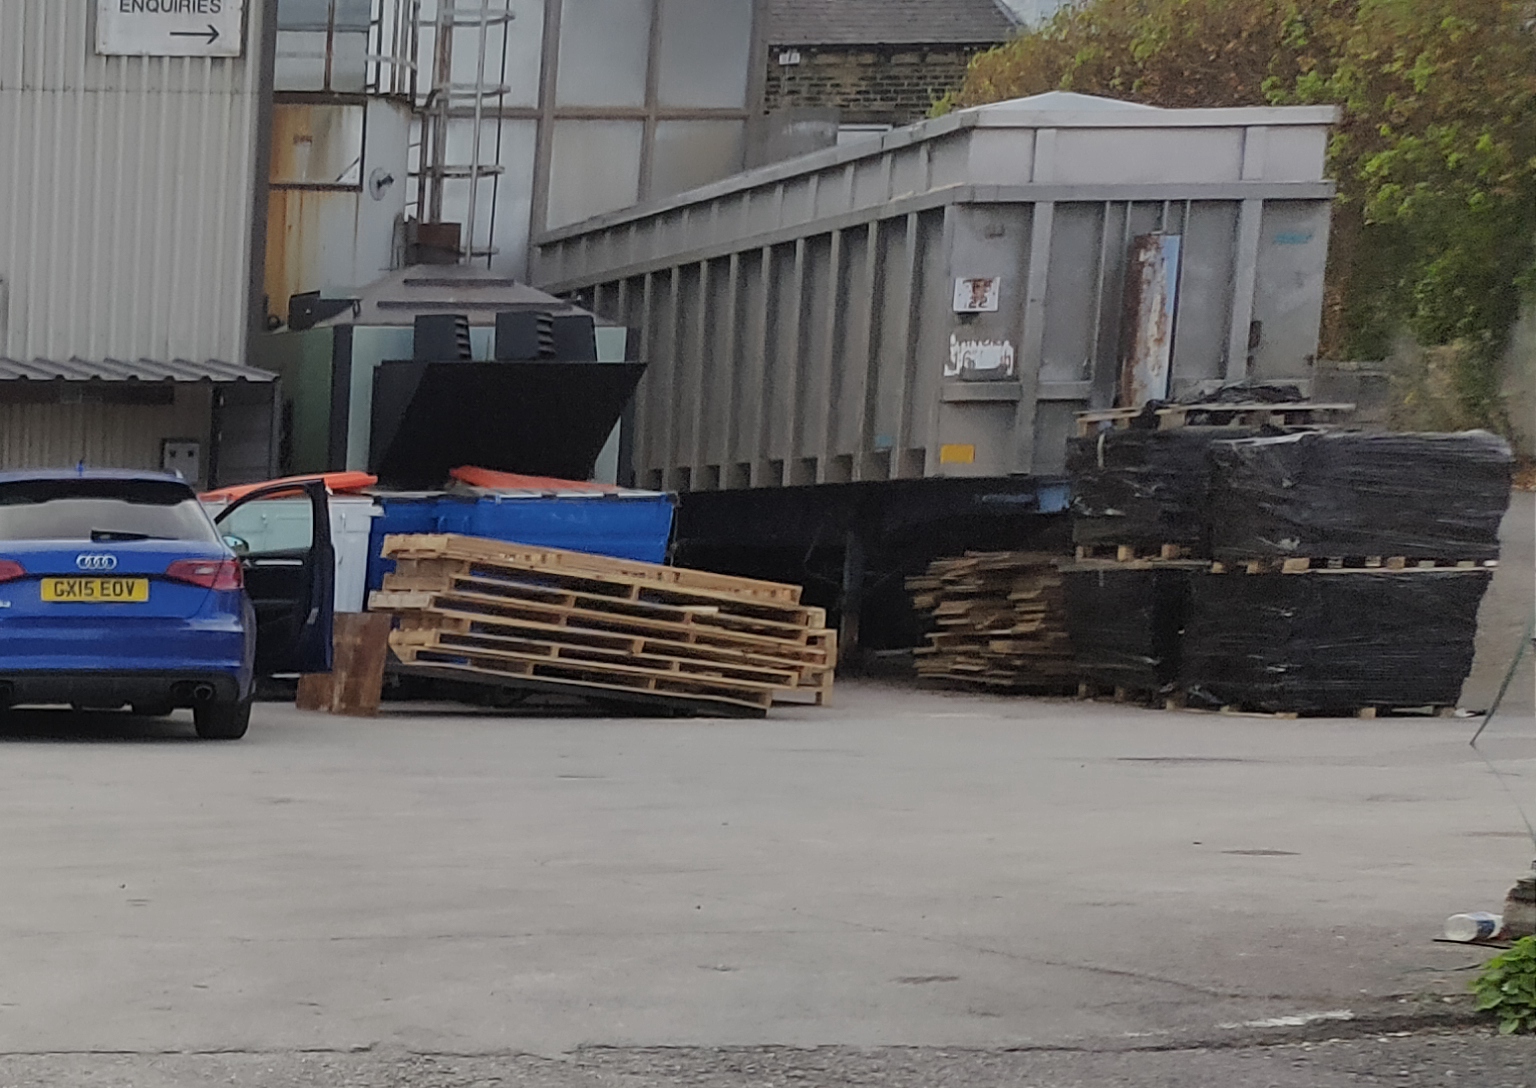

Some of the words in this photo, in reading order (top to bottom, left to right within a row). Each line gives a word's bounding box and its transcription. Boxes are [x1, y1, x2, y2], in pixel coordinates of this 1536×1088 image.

[119, 0, 222, 14] ENQUIRIES
[53, 581, 95, 598] GX15
[100, 580, 135, 598] EOV
